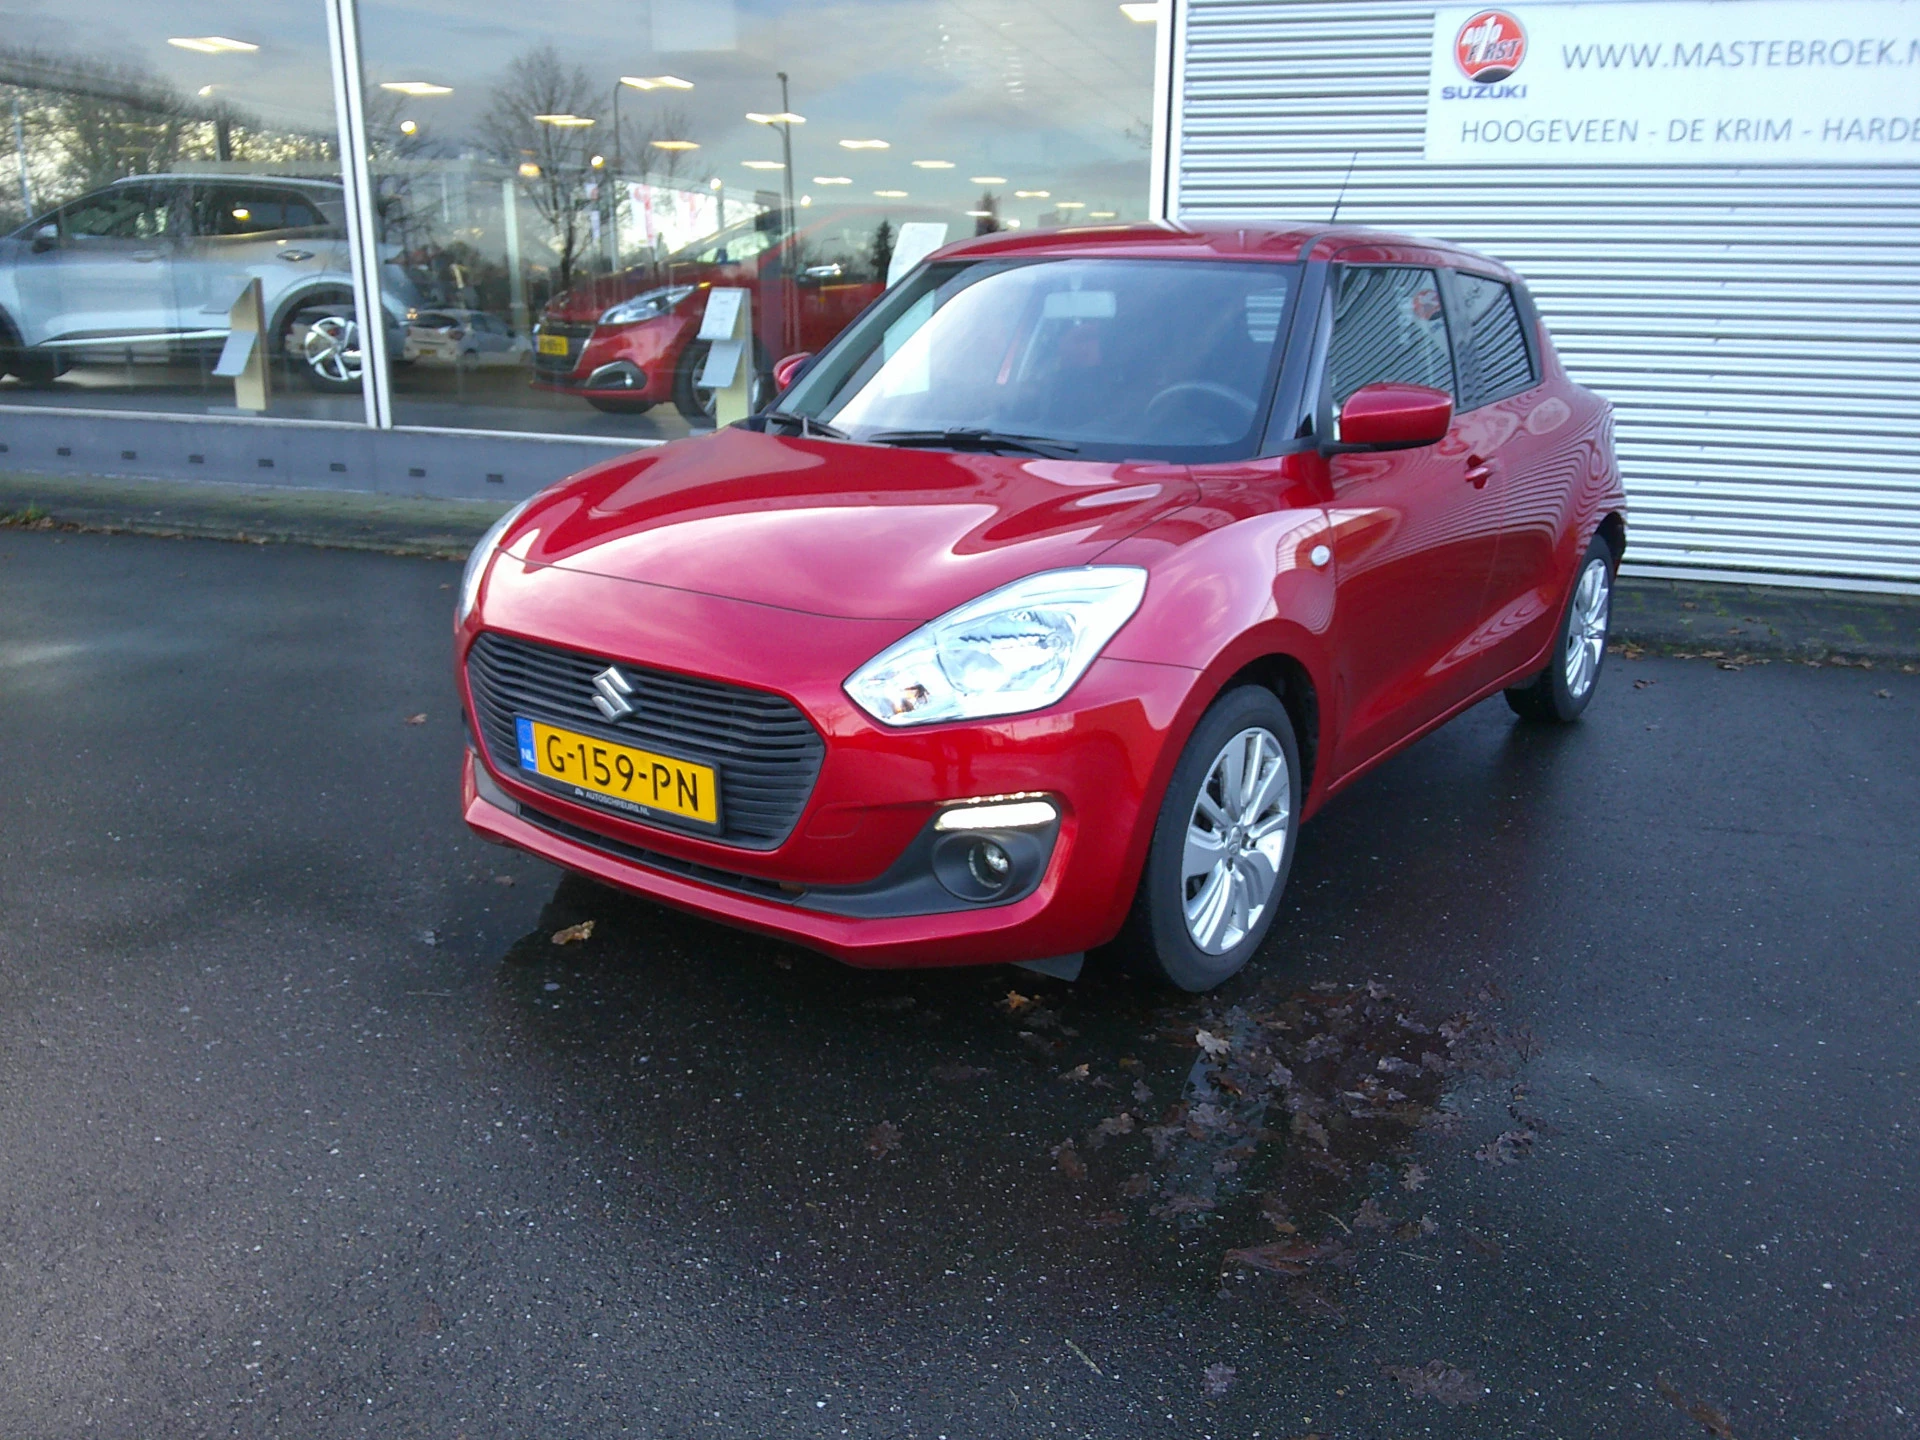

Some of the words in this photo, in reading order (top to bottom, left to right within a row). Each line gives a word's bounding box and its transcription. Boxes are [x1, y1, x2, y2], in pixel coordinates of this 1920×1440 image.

[1442, 85, 1527, 99] SUZUKI
[1461, 119, 1638, 142] HOOGEVEEN
[1668, 118, 1704, 142] DE
[1715, 118, 1793, 142] KRIM
[521, 747, 535, 763] NL
[547, 735, 698, 811] G-159-PN
